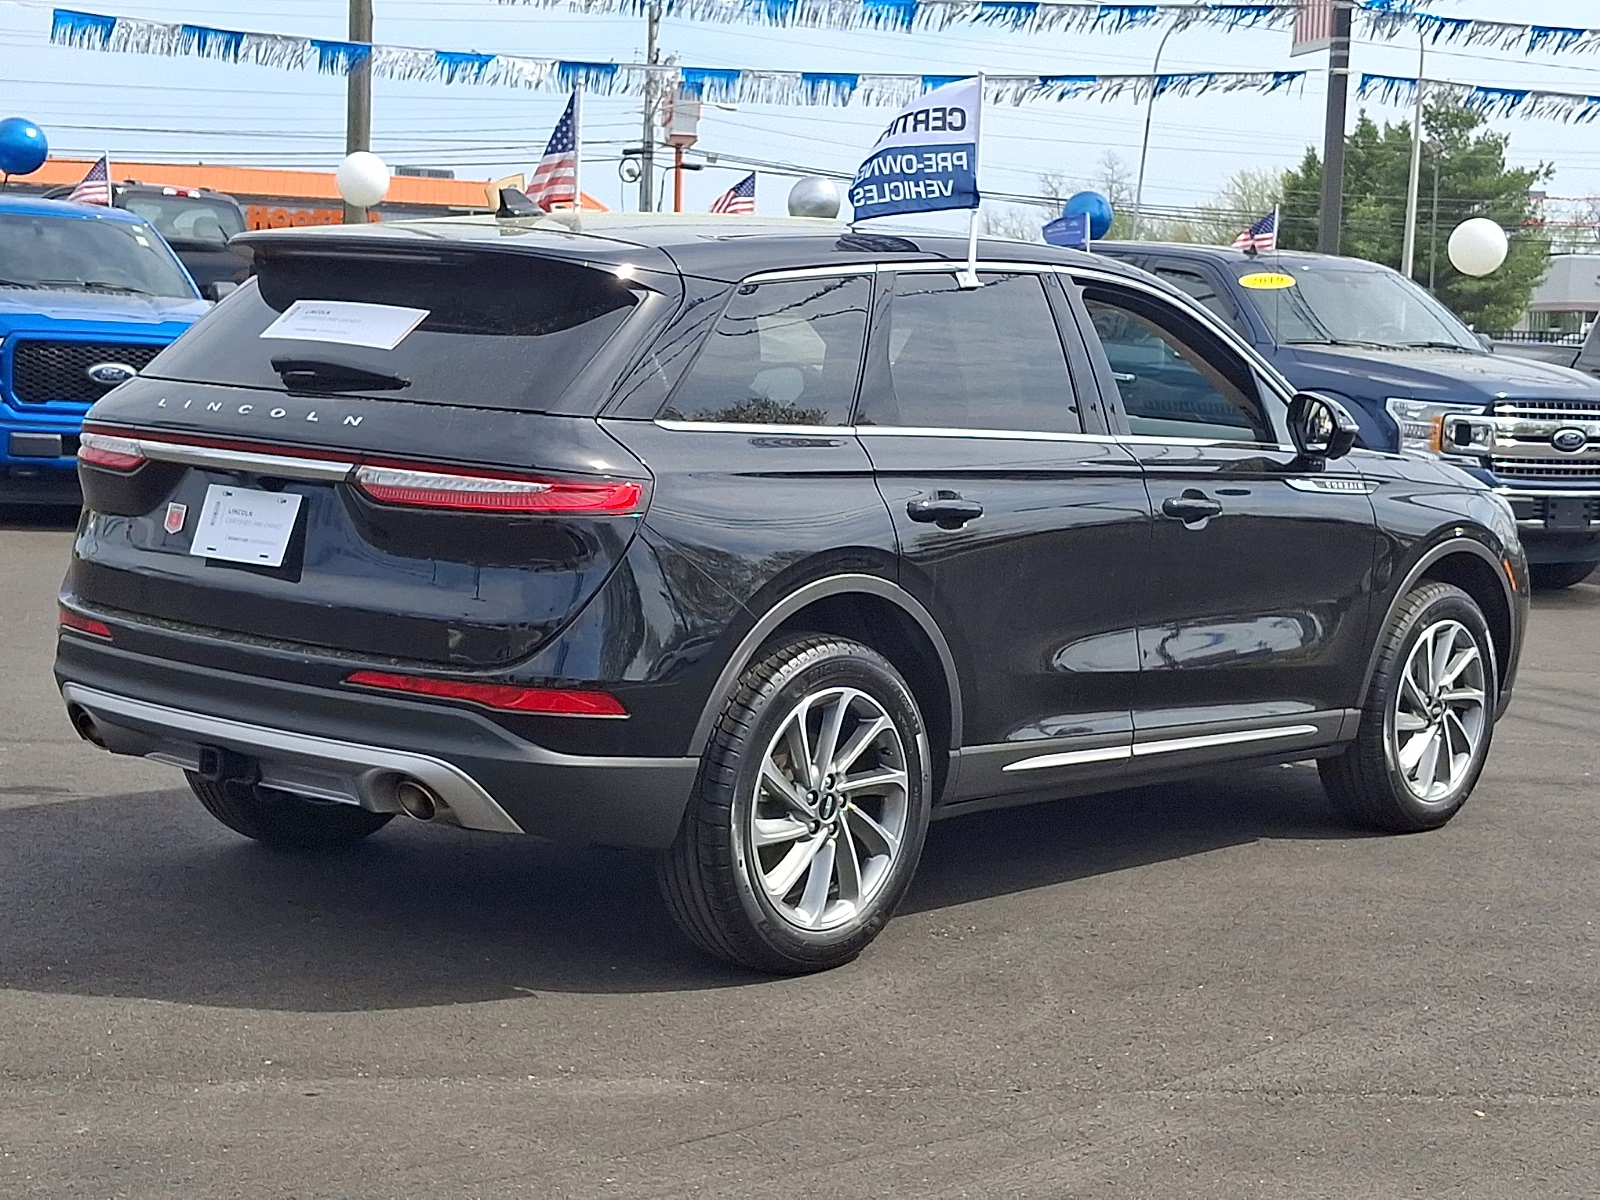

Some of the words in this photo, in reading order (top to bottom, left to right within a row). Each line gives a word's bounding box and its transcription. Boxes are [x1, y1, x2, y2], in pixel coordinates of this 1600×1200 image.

[247, 204, 383, 231] HOOTES
[158, 398, 363, 427] LINCOLN
[1325, 480, 1364, 491] CORSAIR
[228, 507, 254, 517] LINCOLN
